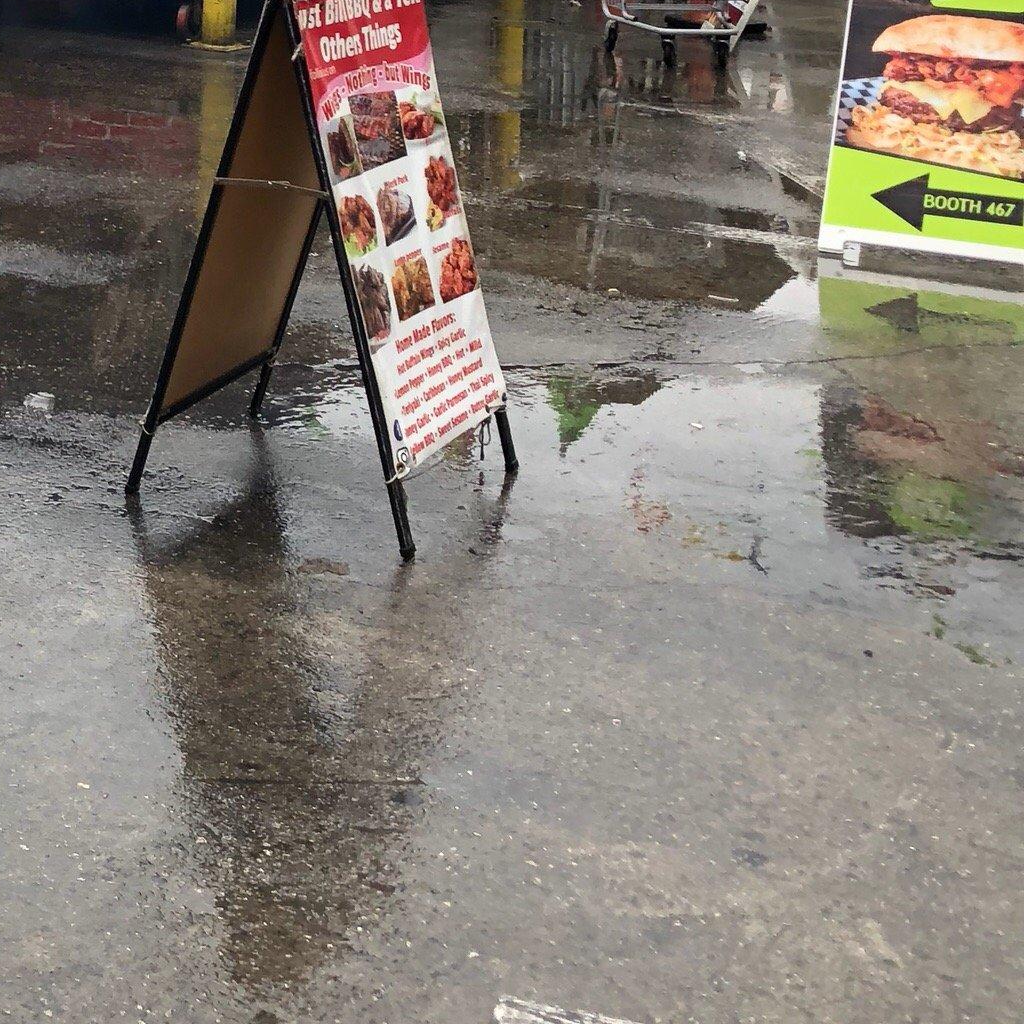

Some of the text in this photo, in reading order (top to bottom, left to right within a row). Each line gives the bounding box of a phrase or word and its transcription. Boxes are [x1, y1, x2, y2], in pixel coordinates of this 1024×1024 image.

[297, 3, 322, 31] ust
[361, 22, 402, 52] Things
[400, 64, 431, 92] Wings
[923, 194, 1016, 217] BOOTH 467
[395, 336, 413, 354] Home
[412, 324, 431, 343] Made
